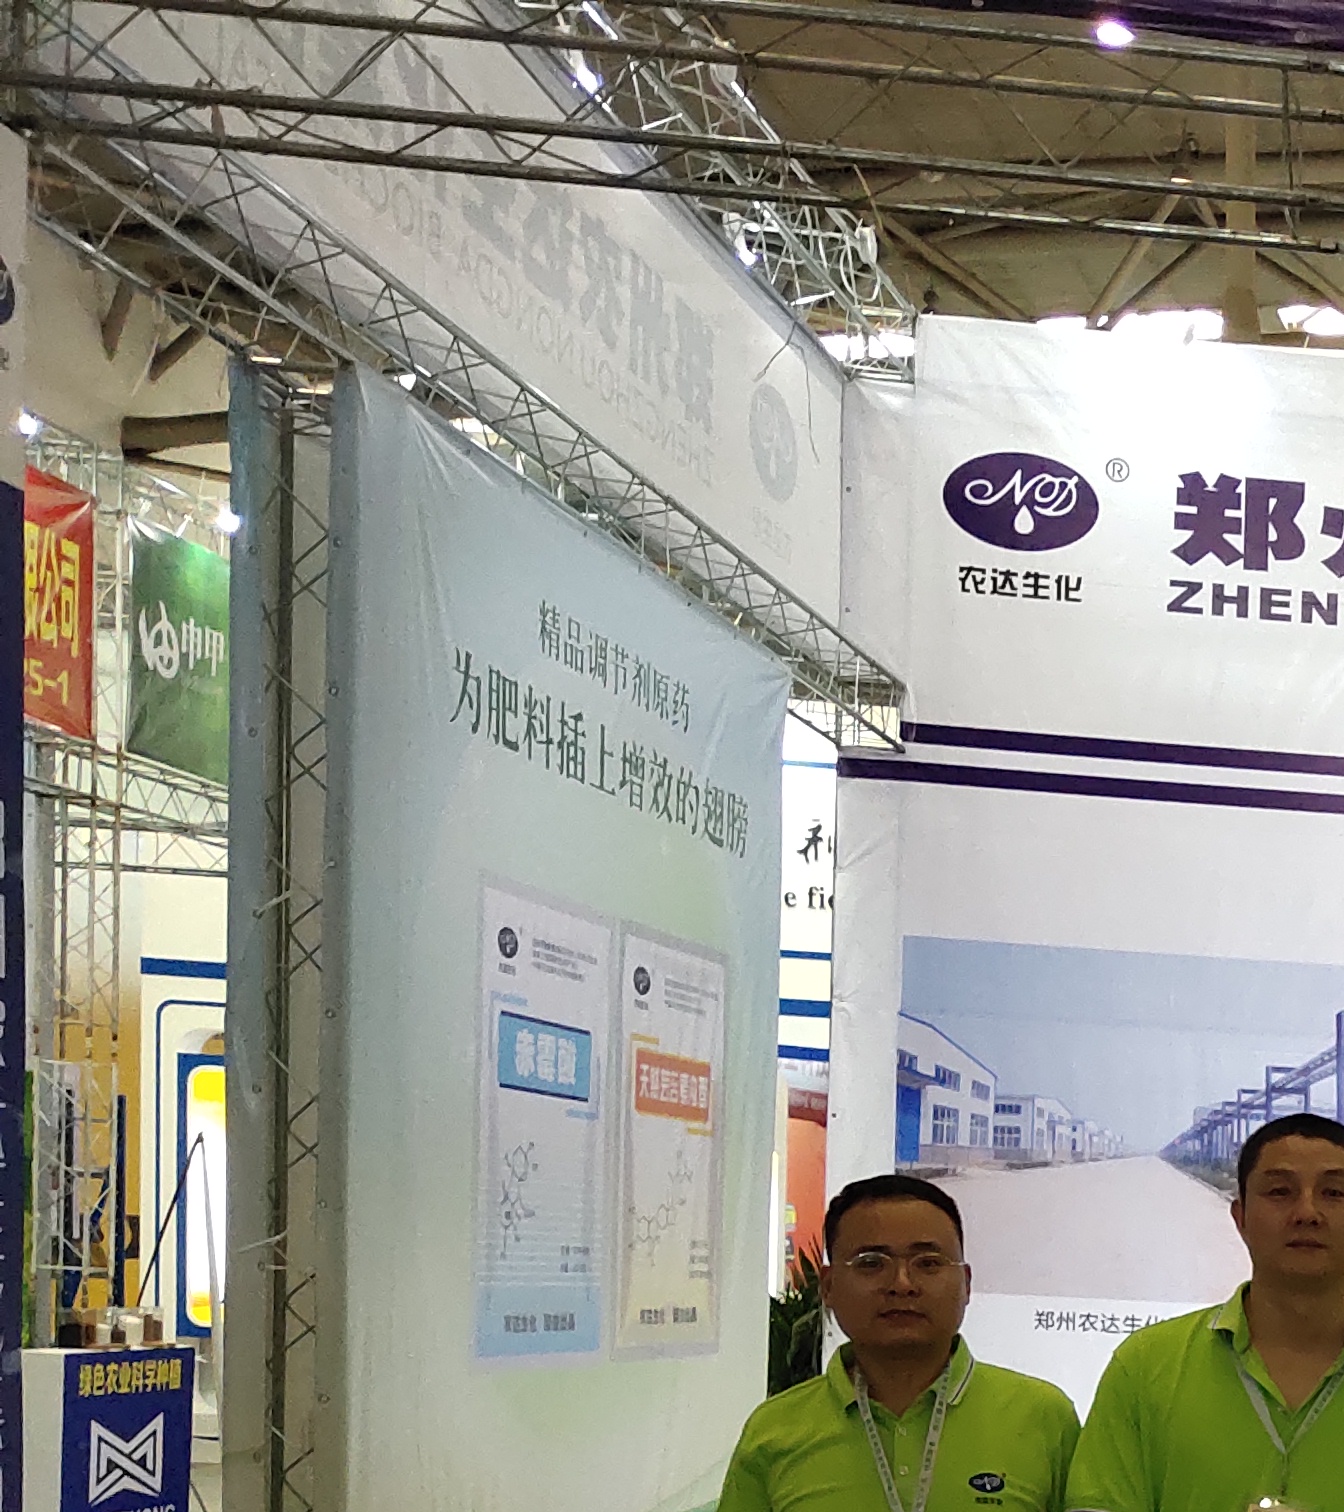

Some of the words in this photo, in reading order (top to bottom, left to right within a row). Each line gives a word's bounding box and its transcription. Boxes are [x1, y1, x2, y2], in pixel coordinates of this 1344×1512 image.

[957, 564, 1082, 604] 农达生化
[537, 599, 690, 734] 精品调节剂原药
[450, 647, 749, 859] 为肥料插上增效的翅膀
